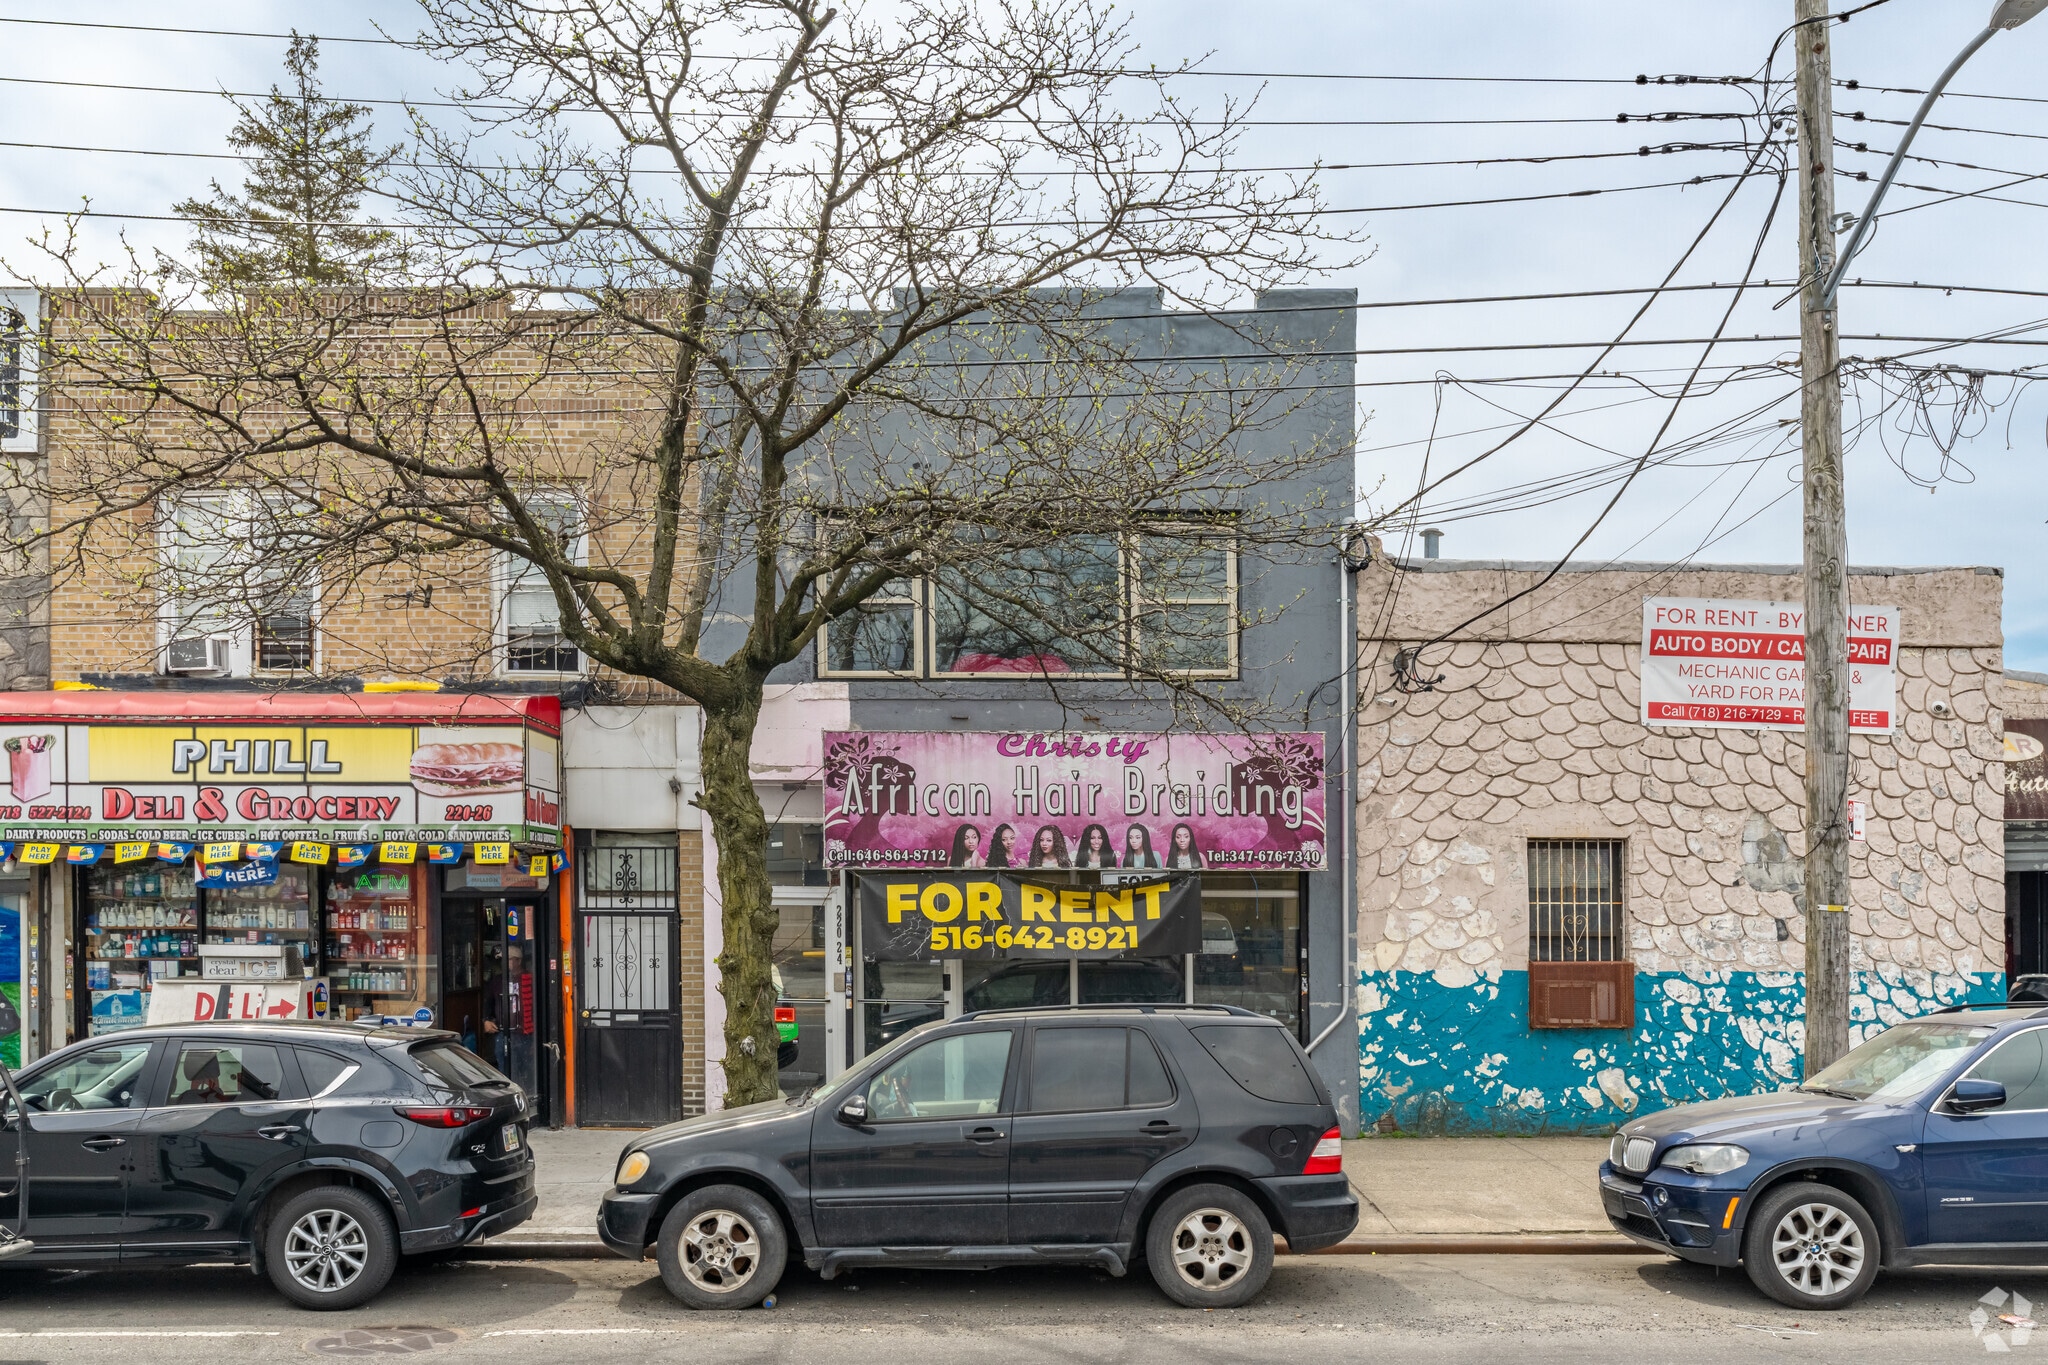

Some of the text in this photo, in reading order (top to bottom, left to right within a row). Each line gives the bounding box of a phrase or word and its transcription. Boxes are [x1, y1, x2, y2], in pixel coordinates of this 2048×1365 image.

[1656, 607, 1696, 625] FOR
[1705, 609, 1758, 627] RENT
[1779, 612, 1803, 629] BY
[1847, 616, 1888, 632] NER
[1653, 635, 1705, 652] AUTO
[1711, 637, 1763, 655] BODY
[1777, 639, 1803, 656] CA
[1847, 643, 1888, 660] PAIR
[1678, 663, 1771, 681] MECHANIC
[1851, 670, 1862, 684] &
[1687, 684, 1735, 699] YARD
[1740, 685, 1774, 701] FOR
[1661, 704, 1685, 717] Call
[1688, 705, 1720, 721] (718)
[1724, 707, 1782, 721] 216-7129
[1852, 711, 1878, 725] FEE
[173, 739, 342, 773] PHILL
[997, 734, 1149, 764] Christy
[841, 762, 1304, 829] African Hair Braiding
[0, 805, 91, 820] 718 527-2124
[193, 787, 228, 822] &
[445, 804, 493, 821] 220-26
[5, 829, 510, 841] DAIRY PRODUCTS SODAS COLD BEER ICE CUBES HOT COFFEE FRUITS HOT & COLD SANDWICHES
[300, 844, 322, 852] PLAY
[828, 849, 946, 862] Cell:646-864-8712
[1207, 849, 1321, 863] Tel:347-676-7340
[225, 867, 272, 882] HERE.
[356, 874, 409, 890] ATM
[886, 882, 1170, 924] FOR RENT
[930, 925, 1138, 951] 516-642-8921
[209, 960, 278, 977] clear ICE
